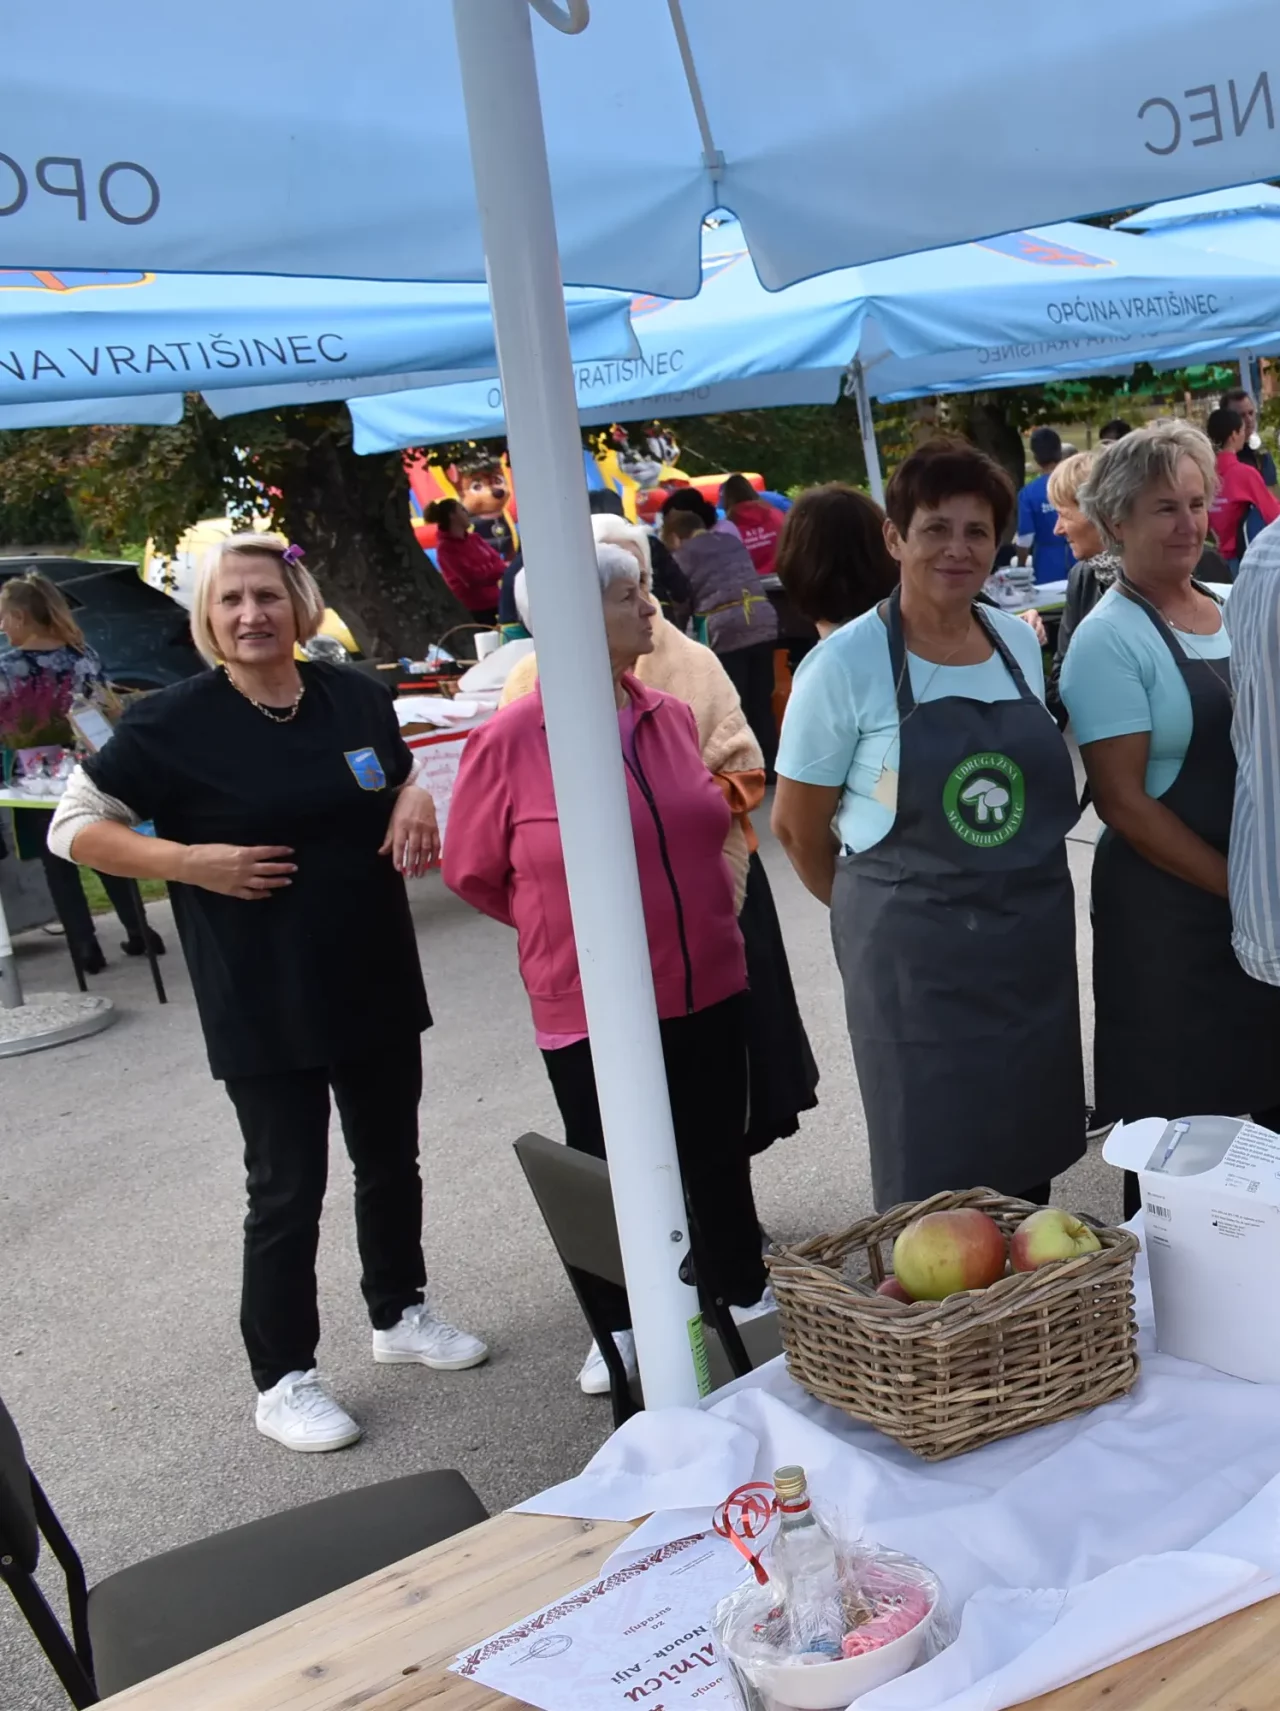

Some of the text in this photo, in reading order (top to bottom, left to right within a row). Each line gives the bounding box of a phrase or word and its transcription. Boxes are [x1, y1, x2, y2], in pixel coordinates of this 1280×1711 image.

[1123, 290, 1219, 318] VRATIŠINEC
[67, 333, 348, 376] VRATIŠINEC
[623, 1605, 672, 1636] suradnju
[651, 1620, 665, 1630] za
